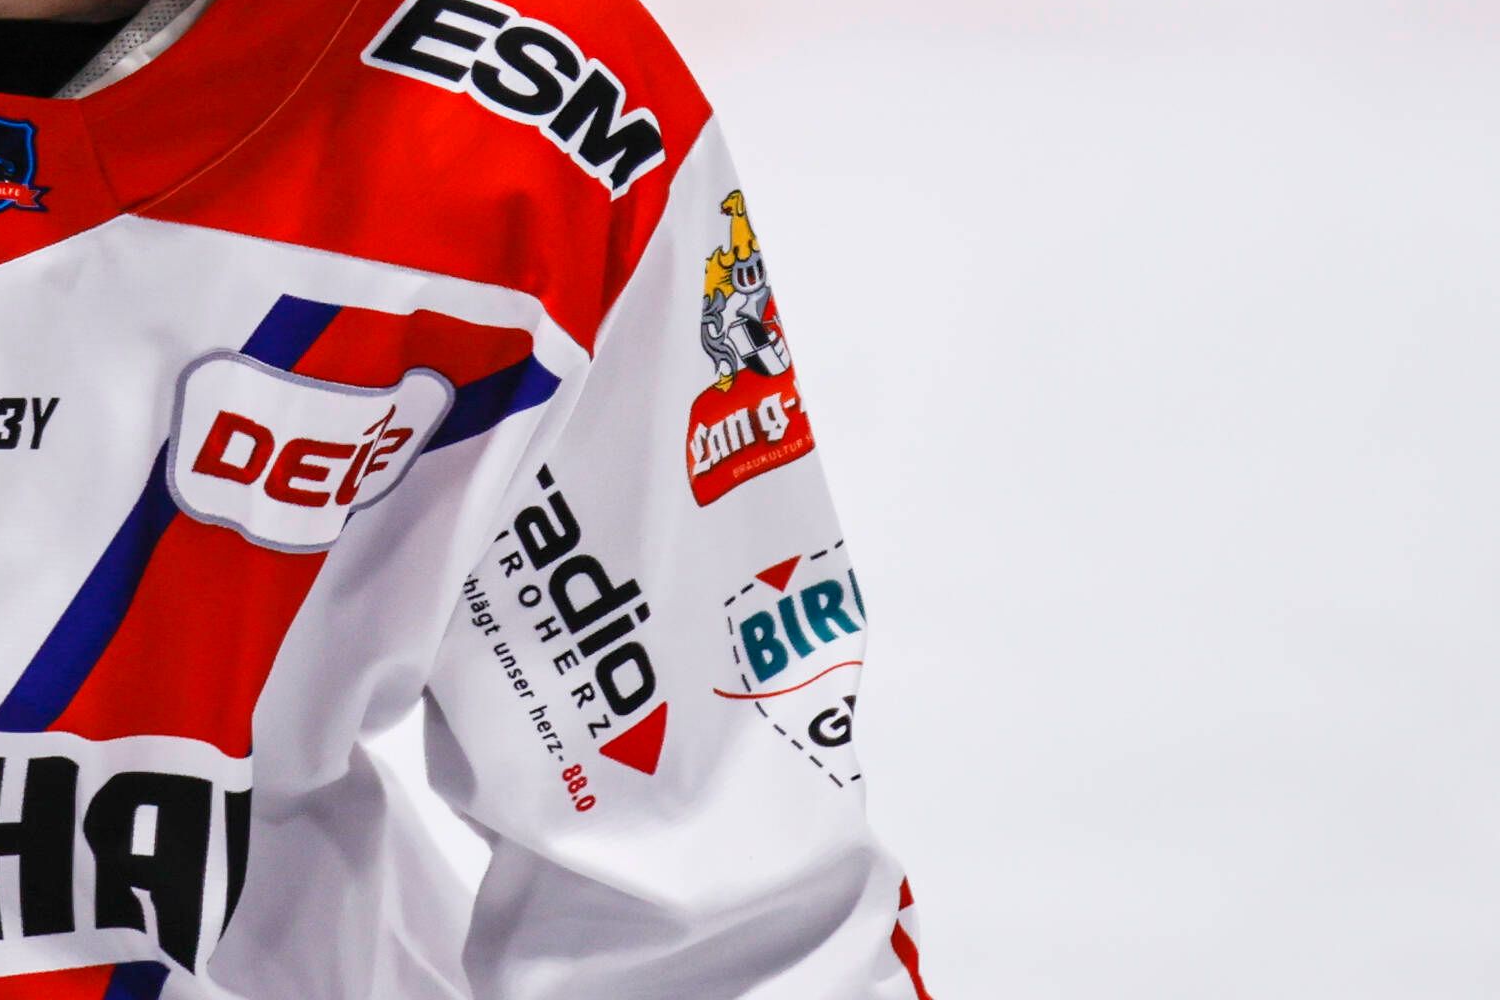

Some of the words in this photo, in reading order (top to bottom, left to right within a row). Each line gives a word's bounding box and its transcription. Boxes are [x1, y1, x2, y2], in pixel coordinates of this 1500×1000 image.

[463, 574, 502, 636] hlägt
[493, 641, 535, 699] unser
[562, 763, 597, 812] 88.0
[493, 529, 612, 739] ROHERZ
[740, 568, 867, 683] BIR
